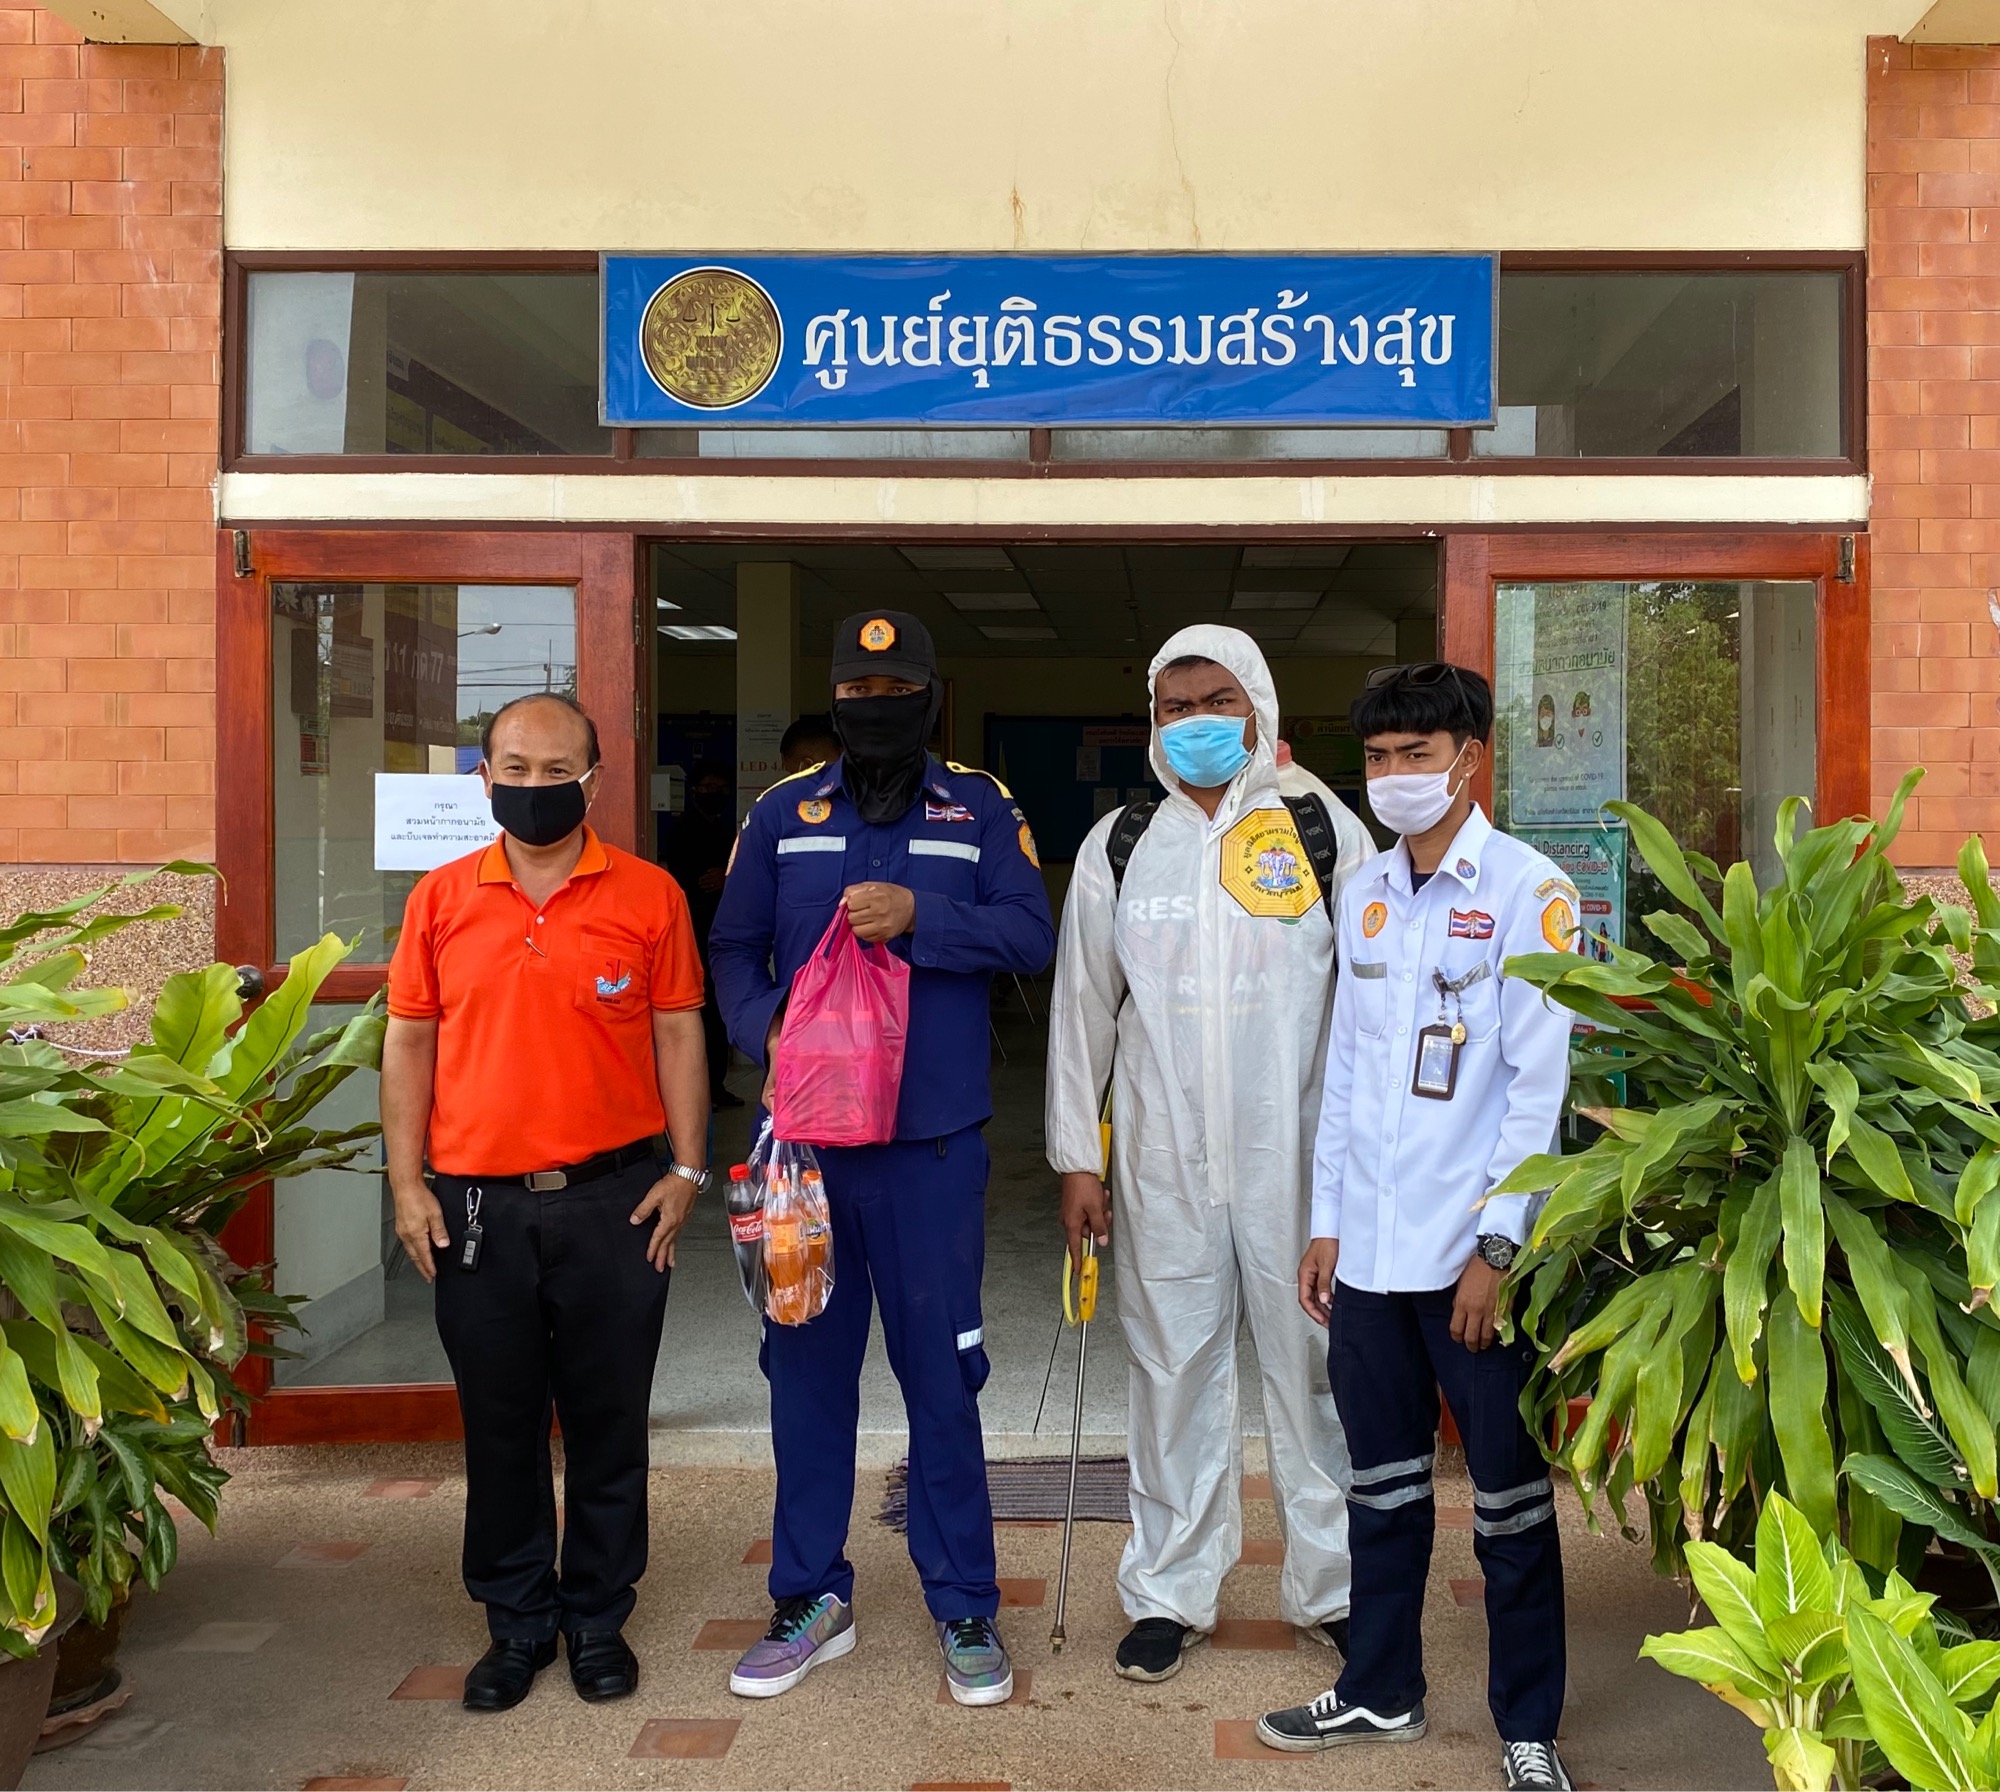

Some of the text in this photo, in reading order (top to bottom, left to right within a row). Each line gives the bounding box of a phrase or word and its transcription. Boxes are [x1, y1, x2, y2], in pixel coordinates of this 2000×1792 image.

[802, 289, 1456, 390] ศูนย์ยุติธรรมสร้างสุข
[741, 761, 767, 772] LED
[434, 802, 458, 812] กรุณา
[406, 815, 486, 826] สวมหน้ากากอนามัย
[1543, 840, 1590, 860] Distancing
[1576, 860, 1609, 874] COVID-19
[1321, 872, 1333, 883] VS
[1586, 903, 1608, 913] COVID-19
